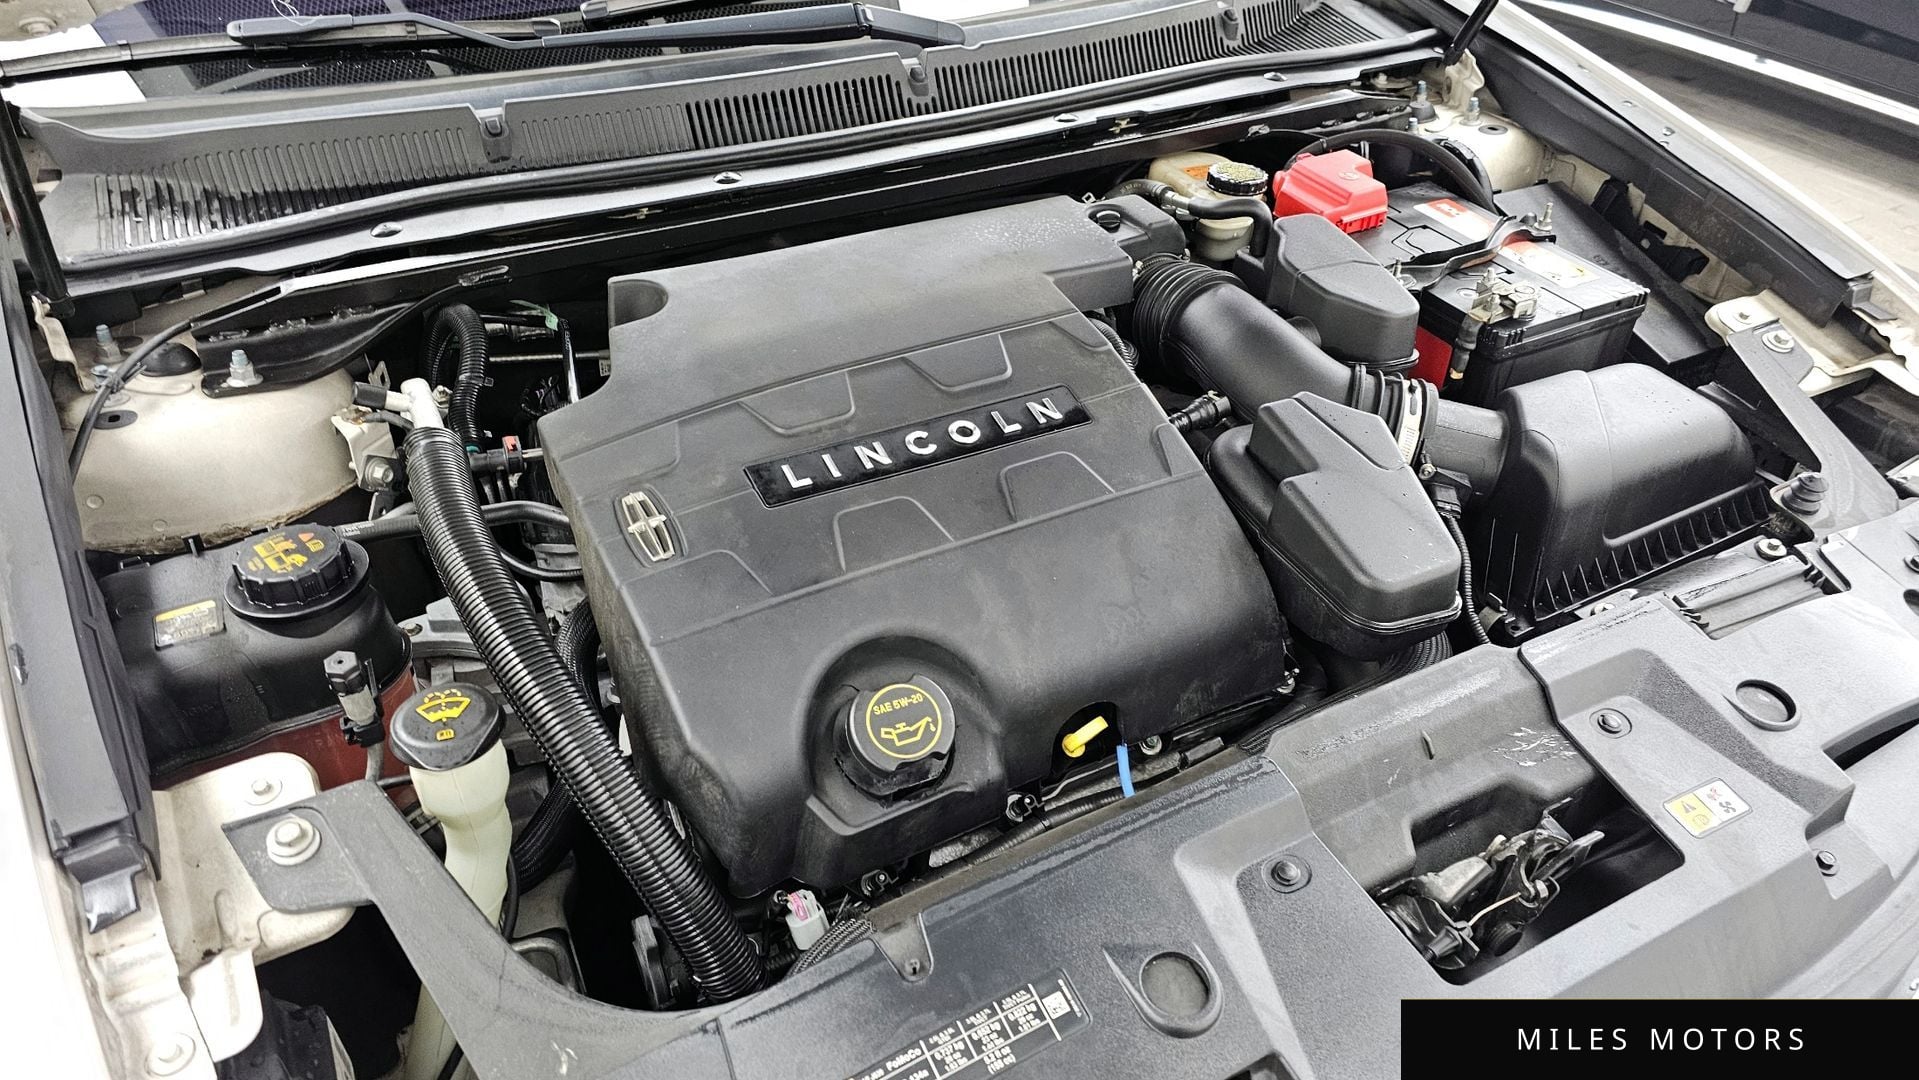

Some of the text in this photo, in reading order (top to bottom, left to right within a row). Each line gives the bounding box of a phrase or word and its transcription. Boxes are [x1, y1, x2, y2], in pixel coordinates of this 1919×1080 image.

[781, 398, 1063, 488] LINCOLN
[873, 693, 924, 715] SAE 5W-20
[886, 1048, 921, 1071] FoMoCo
